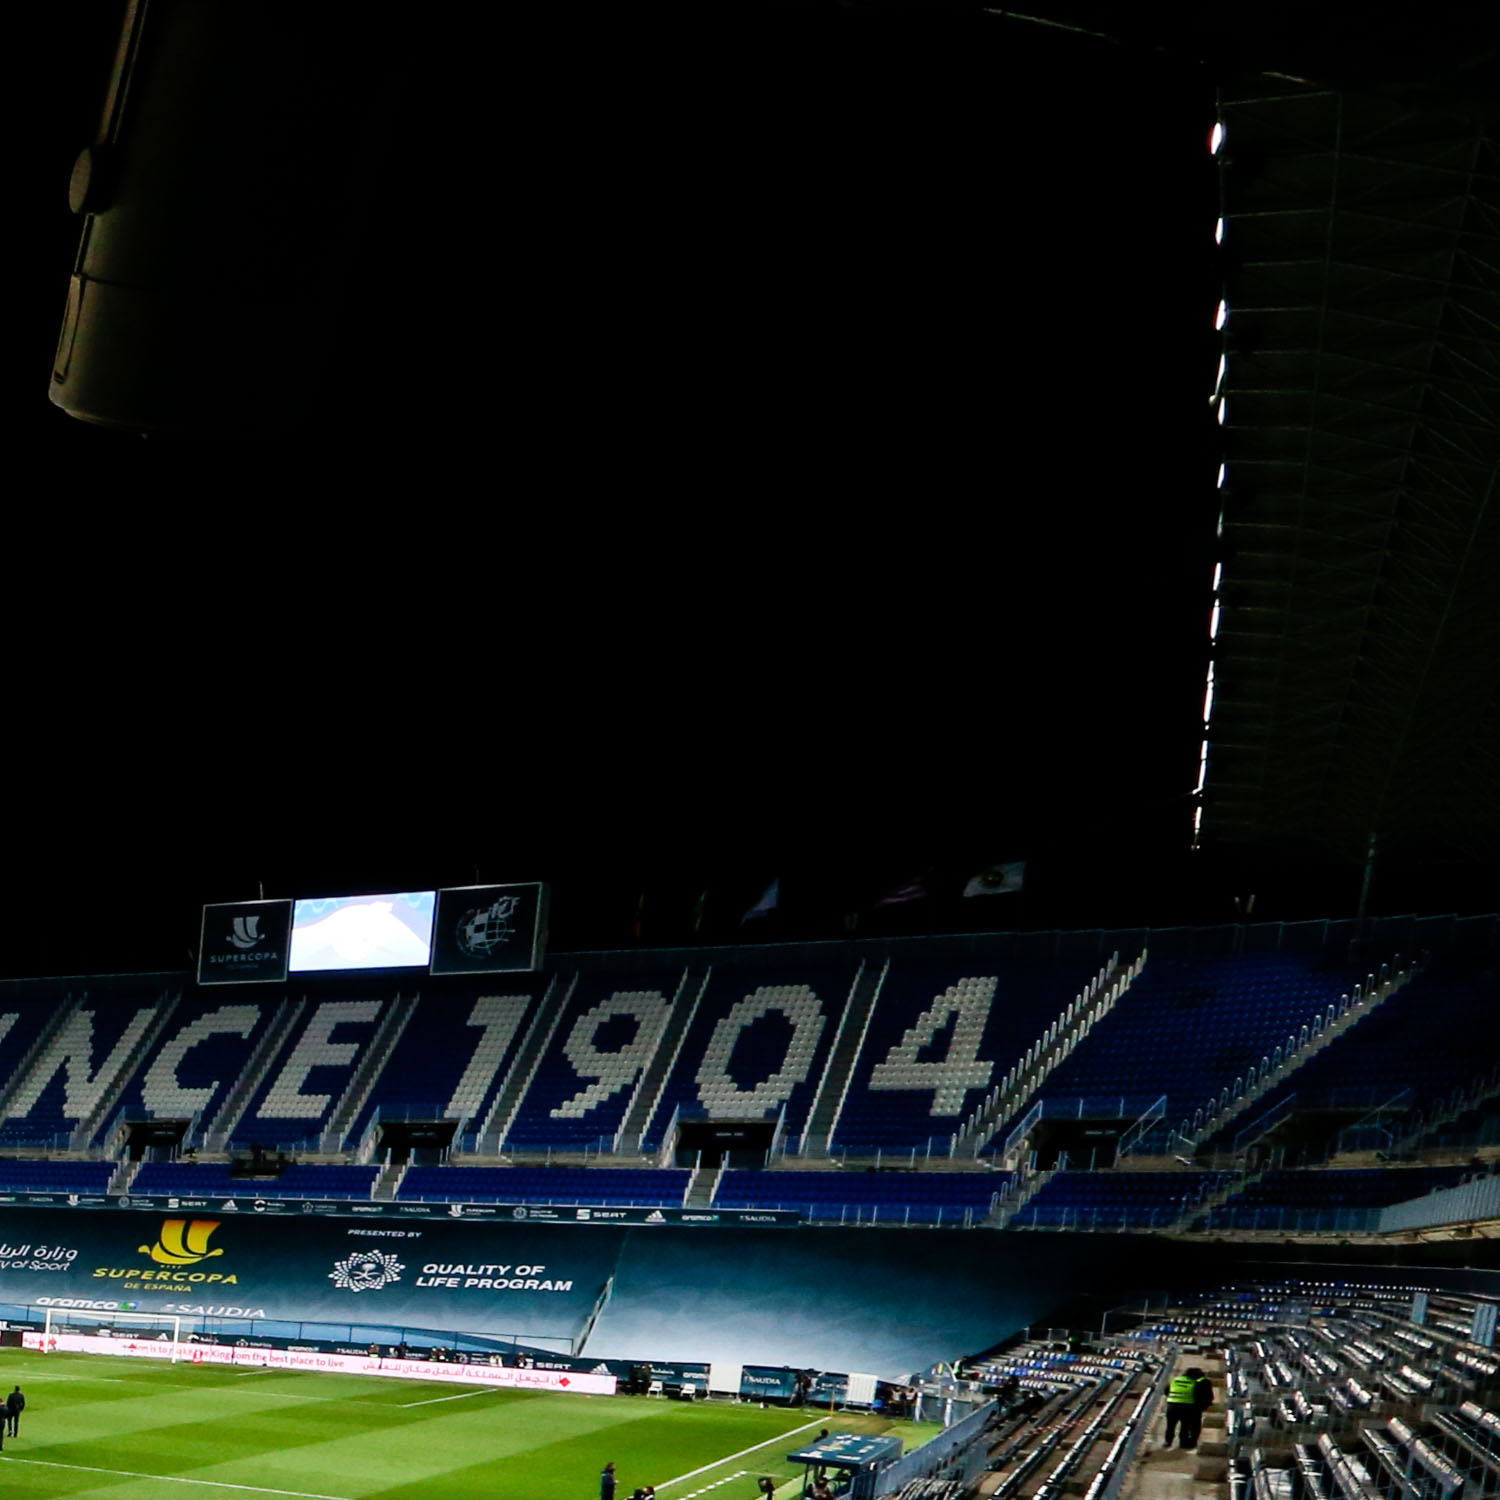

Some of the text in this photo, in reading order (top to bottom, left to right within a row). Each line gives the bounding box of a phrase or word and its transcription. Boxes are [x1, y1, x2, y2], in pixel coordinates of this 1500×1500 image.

[209, 952, 278, 963] SUPERCOPA
[444, 976, 999, 1120] 1904
[593, 1211, 627, 1219] SEAT
[681, 1214, 712, 1222] aramco
[744, 1215, 777, 1223] SAUDIA
[347, 1228, 422, 1238] PRESENTED BY
[34, 1246, 78, 1262] وزارة
[11, 1258, 27, 1269] of
[28, 1258, 70, 1272] Sport
[422, 1263, 545, 1276] QUALITY OF
[93, 1267, 238, 1285] SUPERCOPA
[124, 1281, 191, 1293] DE ESPAÑA
[416, 1276, 574, 1292] LIFE PROGRAM
[36, 1297, 118, 1310] aramco
[176, 1304, 266, 1318] SAUDIA
[252, 1352, 268, 1362] the
[270, 1354, 288, 1364] best
[290, 1355, 314, 1366] place
[316, 1356, 326, 1365] to
[327, 1357, 344, 1367] live
[536, 1362, 572, 1370] SEAT
